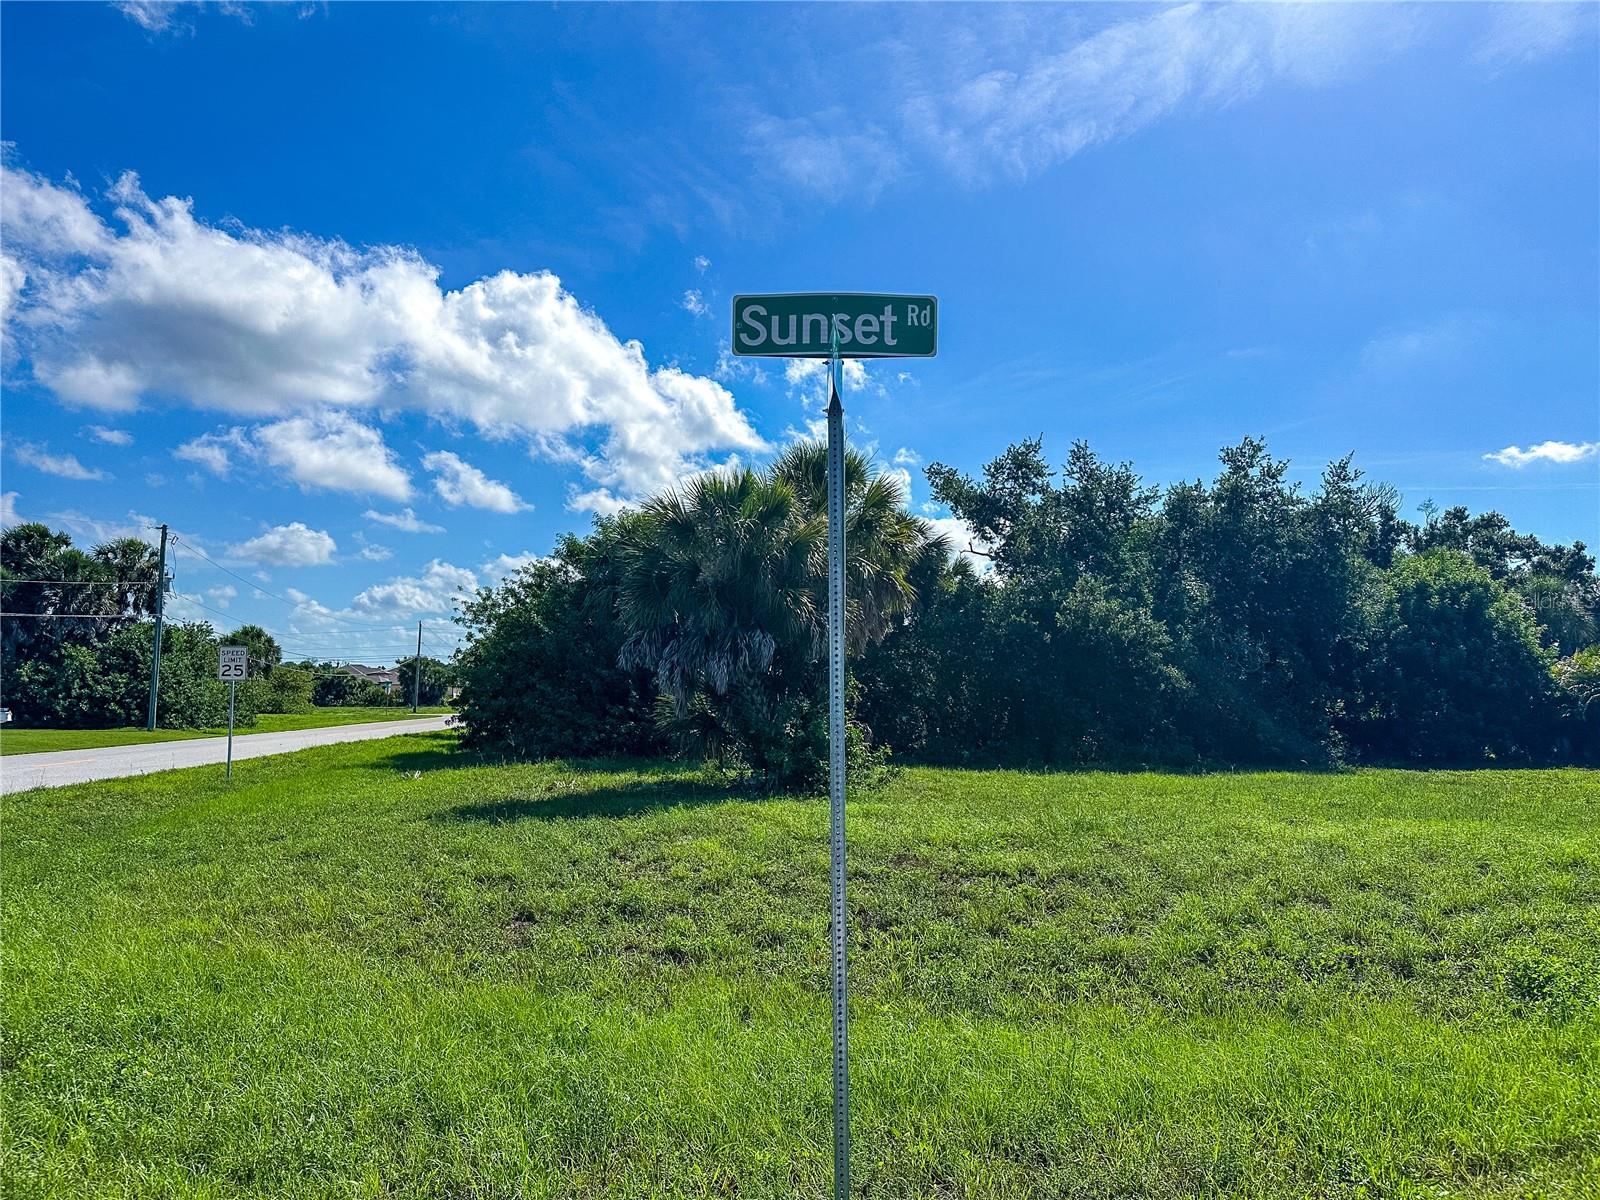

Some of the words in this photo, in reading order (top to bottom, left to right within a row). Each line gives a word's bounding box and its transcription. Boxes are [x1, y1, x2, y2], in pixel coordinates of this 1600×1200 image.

[739, 303, 898, 347] Sunset
[907, 304, 931, 327] Rd
[221, 664, 244, 677] 25
